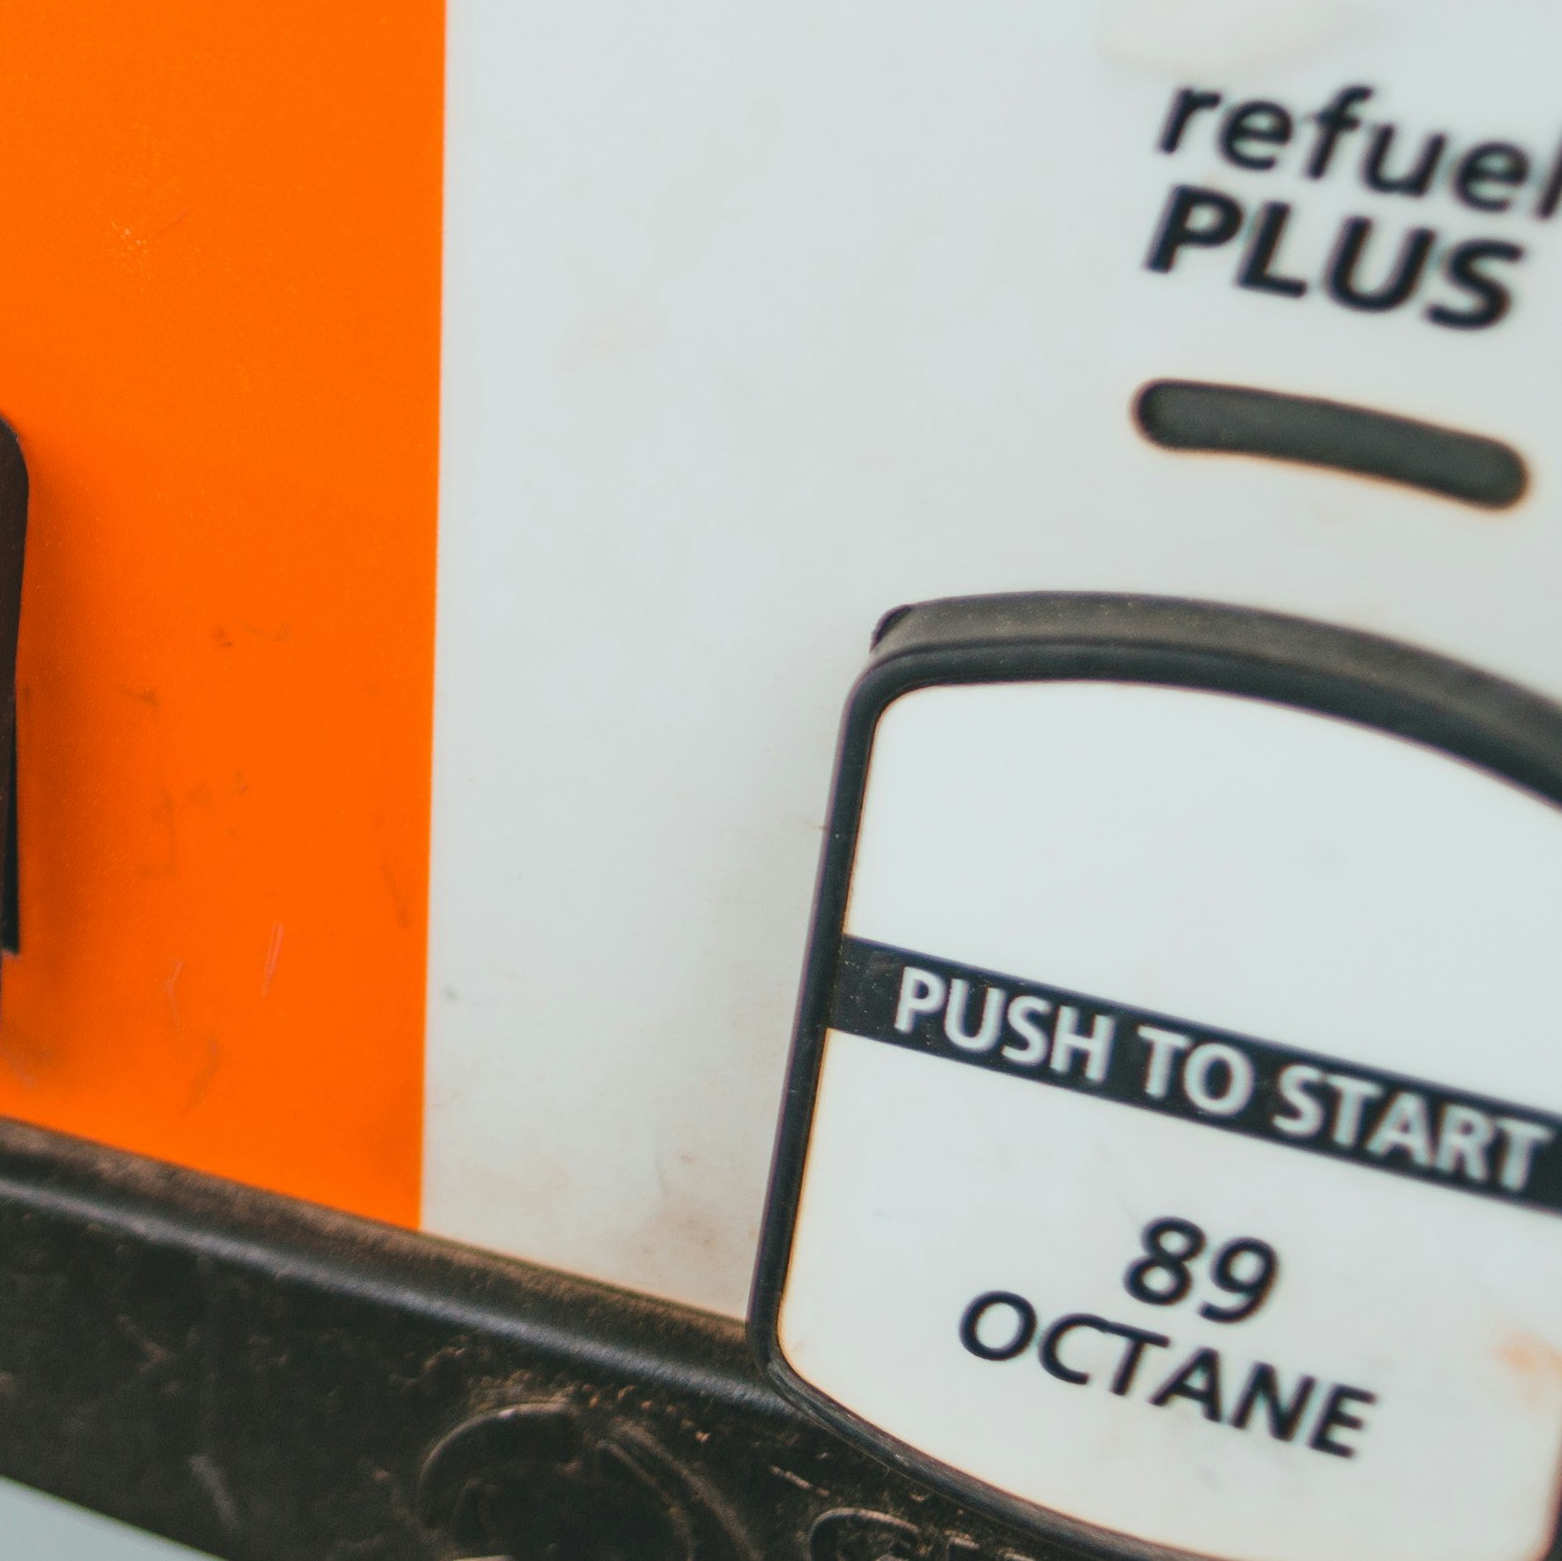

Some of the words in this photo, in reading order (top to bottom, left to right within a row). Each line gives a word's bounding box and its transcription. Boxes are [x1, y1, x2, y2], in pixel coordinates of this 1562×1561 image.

[1144, 183, 1527, 333] PLUS
[894, 966, 1114, 1086] PUSH
[1137, 1026, 1255, 1118] TO
[1272, 1064, 1549, 1193] START
[1122, 1216, 1282, 1326] 89
[959, 1290, 1378, 1459] OCTANE
